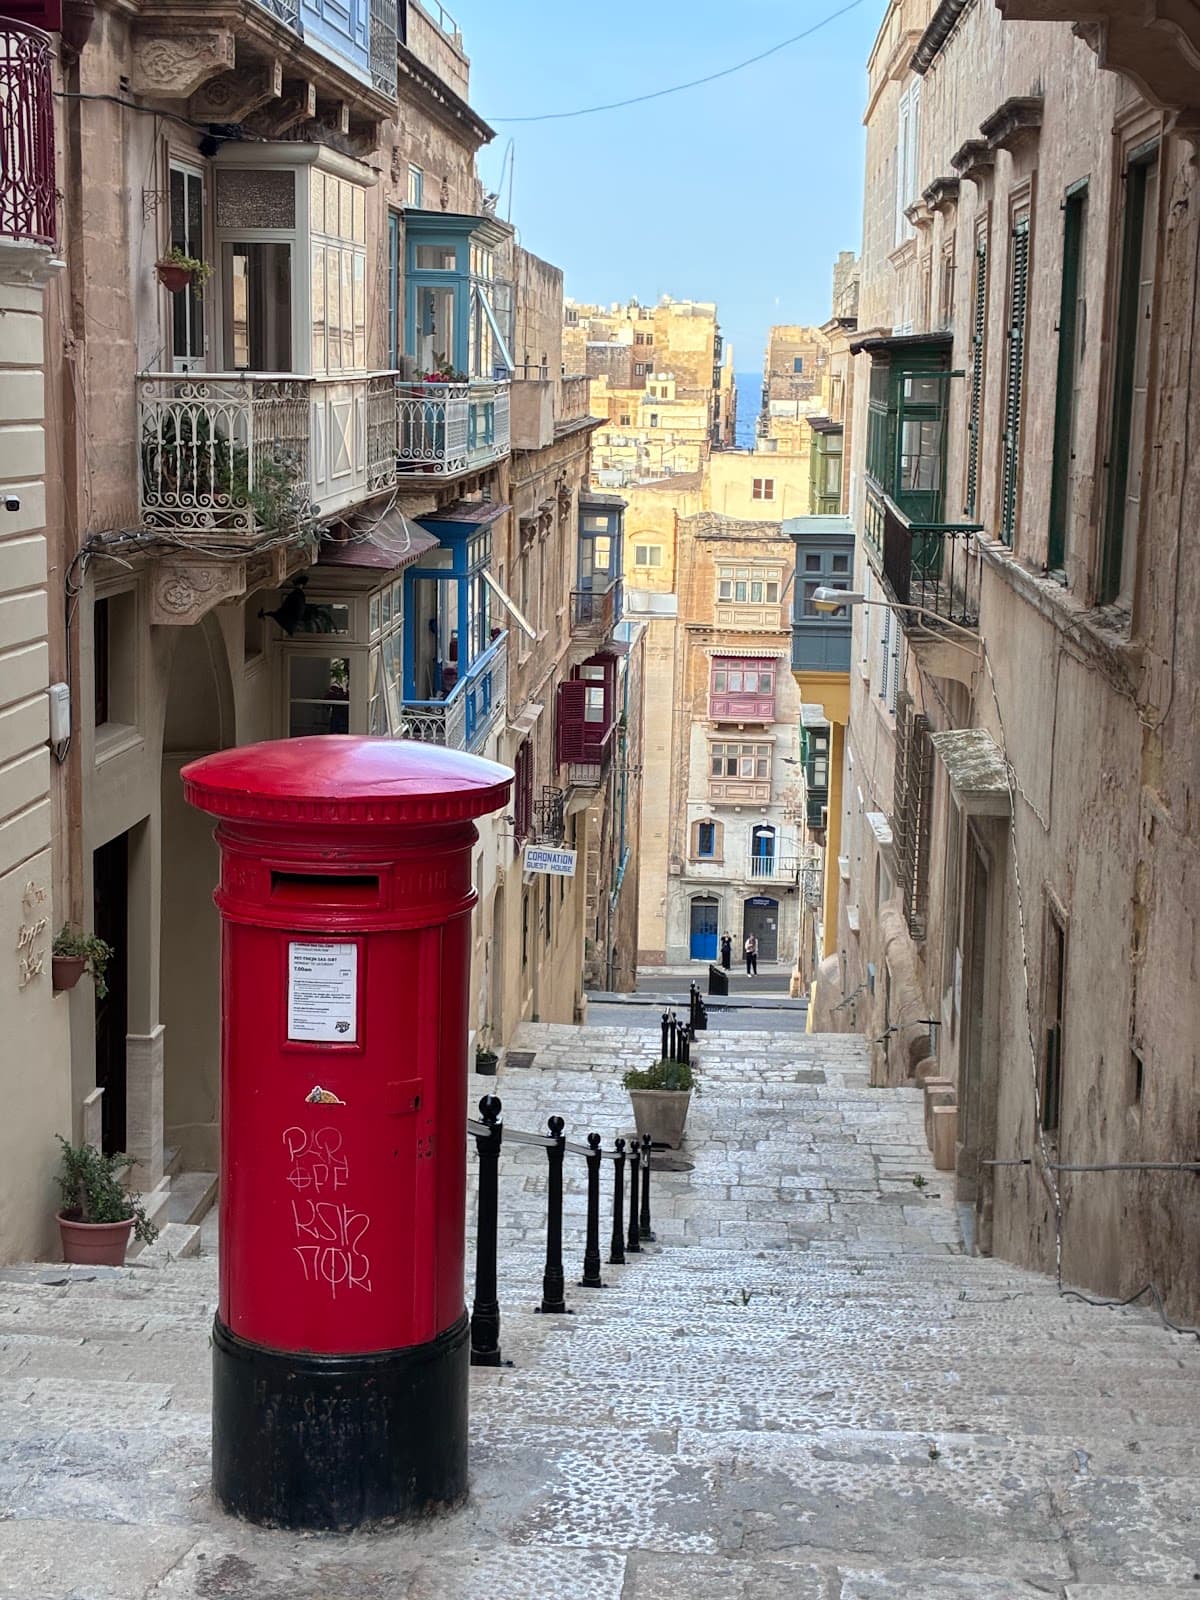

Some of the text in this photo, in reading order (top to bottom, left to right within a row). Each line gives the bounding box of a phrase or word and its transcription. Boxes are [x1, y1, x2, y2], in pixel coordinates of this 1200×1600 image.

[528, 851, 573, 865] CORONATION
[526, 861, 572, 873] GUEST HOUSE
